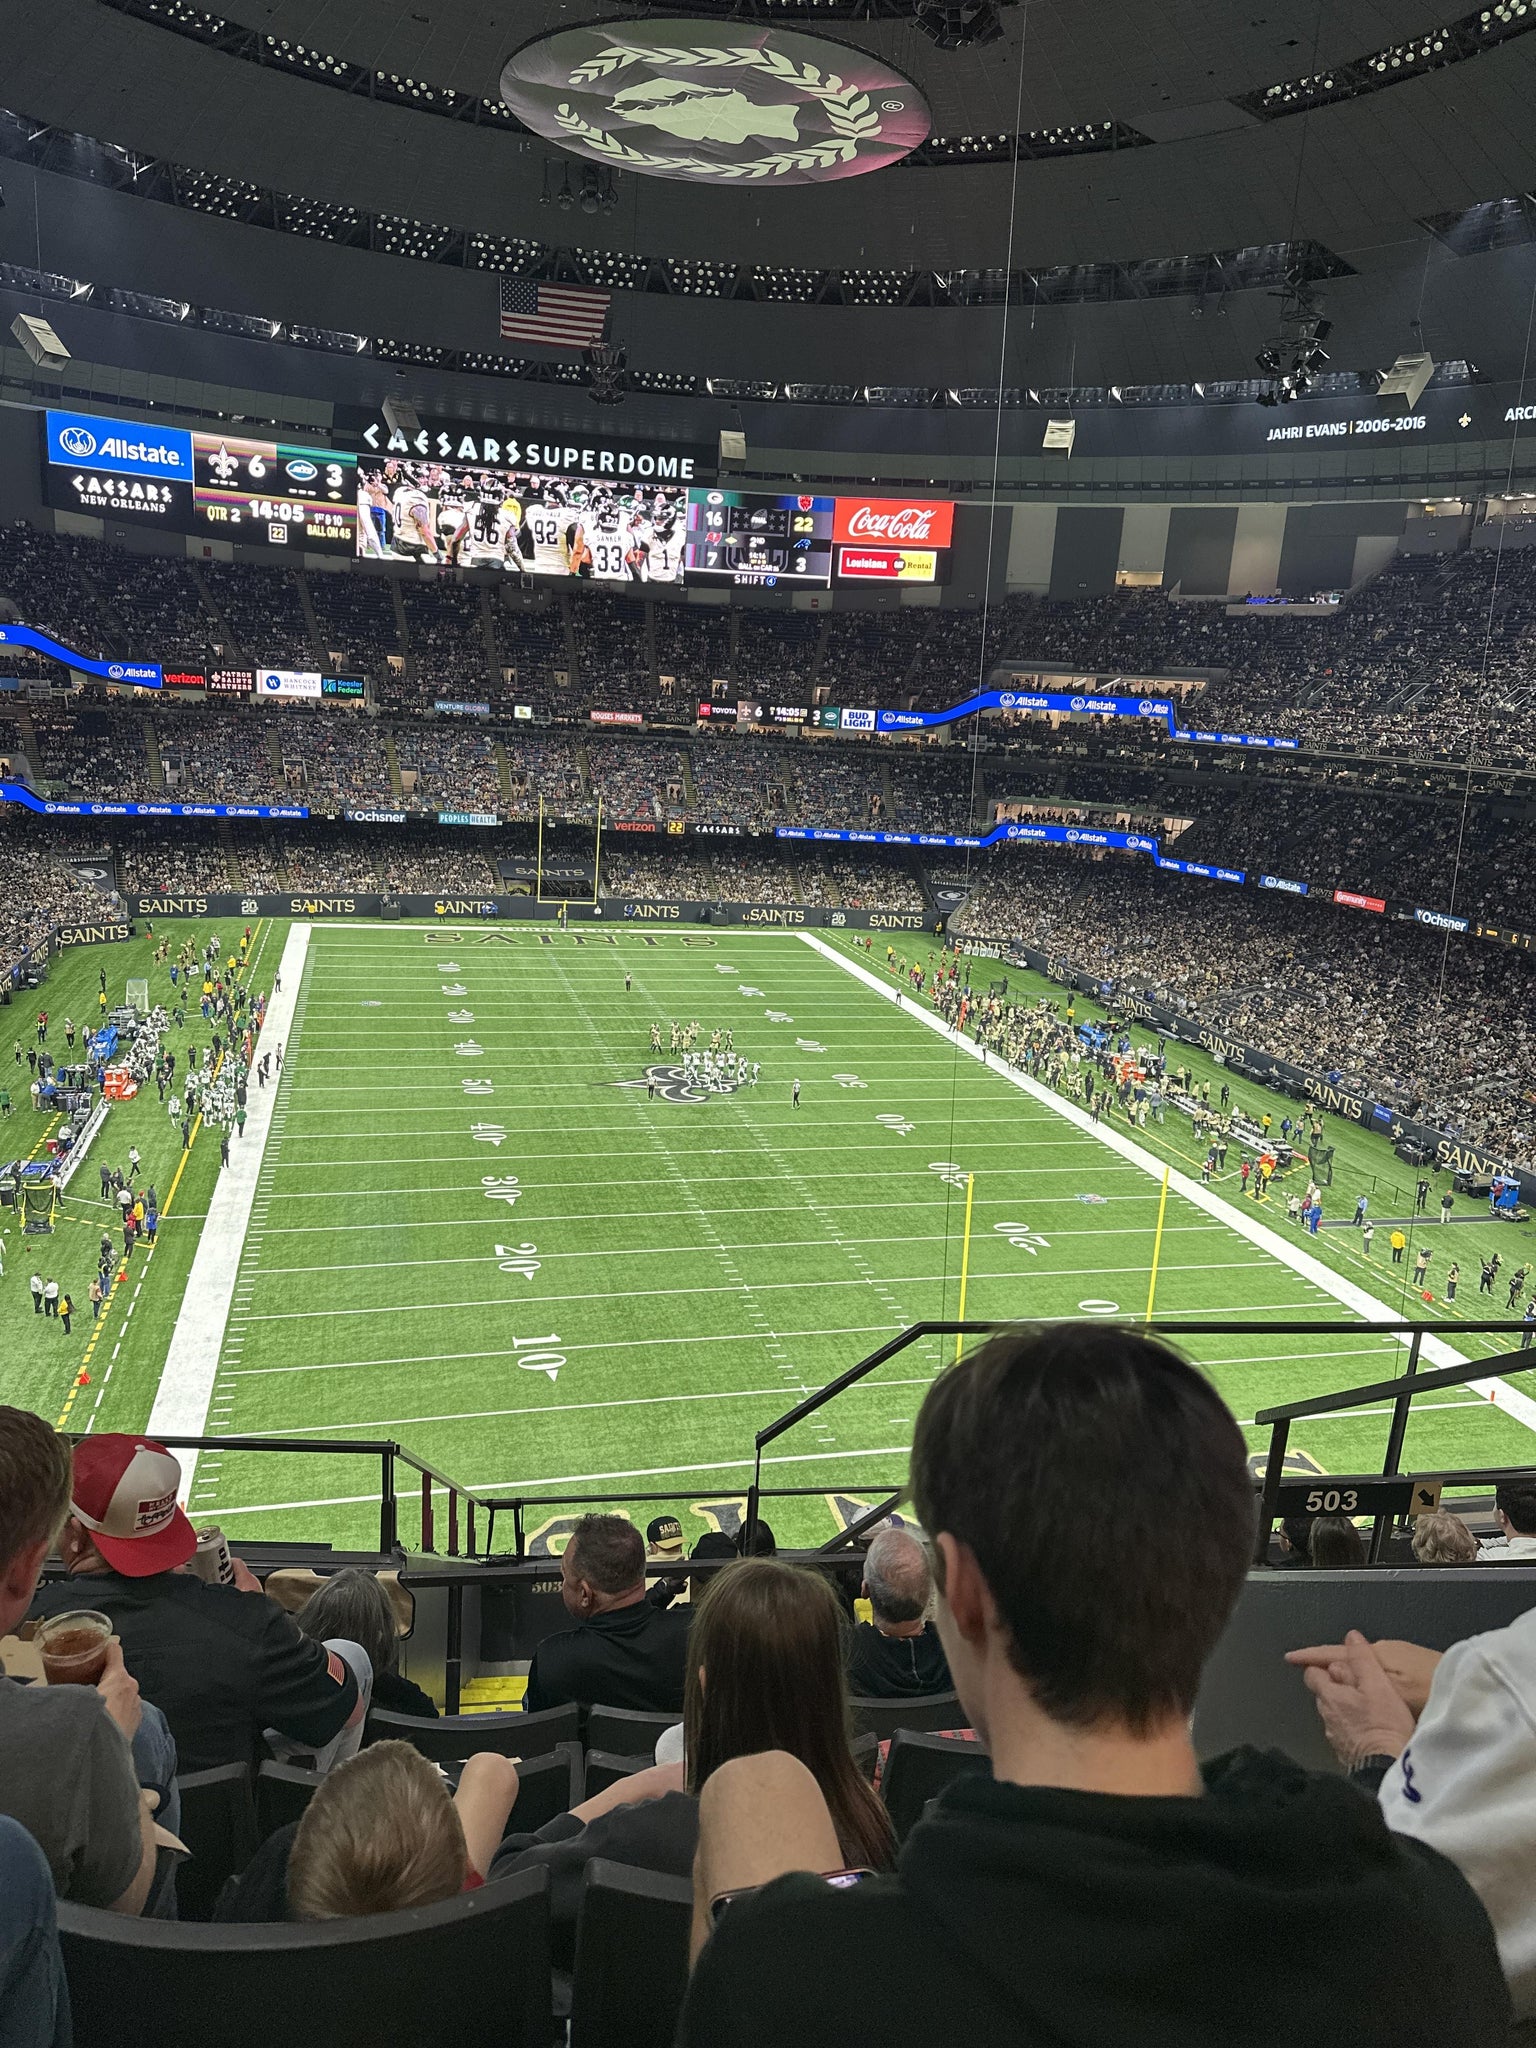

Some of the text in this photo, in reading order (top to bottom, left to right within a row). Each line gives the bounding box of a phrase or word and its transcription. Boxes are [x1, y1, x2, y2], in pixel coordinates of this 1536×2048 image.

[1267, 416, 1426, 441] JAHRI EVANS 2006-2016
[363, 423, 695, 480] CAESARS SUPERDOME
[248, 454, 266, 478] 6
[326, 463, 343, 487] 3
[72, 474, 173, 503] CAESARS
[80, 493, 166, 513] NEW ORLEANS
[207, 505, 241, 523] QTR 2
[249, 499, 305, 523] 14:05
[332, 514, 343, 527] 10
[705, 511, 723, 527] 16
[751, 516, 767, 524] FINAL
[794, 516, 814, 532] 22
[848, 505, 937, 540] Coca-Cola
[272, 526, 284, 539] 22
[306, 523, 352, 540] BALL ON 45
[473, 514, 500, 545] 56
[534, 519, 558, 545] 92
[596, 545, 623, 573] 33
[662, 548, 670, 570] 1
[707, 552, 718, 566] 7
[795, 557, 807, 573] 3
[846, 556, 888, 569] Louisiana
[907, 561, 932, 569] Rental
[163, 672, 204, 684] verizon
[221, 670, 252, 679] PATRON
[211, 683, 252, 691] PARTNERS
[337, 679, 363, 688] Keesler
[337, 686, 363, 694] Federal
[436, 702, 489, 712] VENTURE GLOBAL
[711, 706, 737, 714] TOYOTA
[754, 706, 763, 717] 6
[776, 706, 800, 717] 14:05
[614, 713, 642, 722] MARKETS
[812, 710, 821, 720] 3
[848, 711, 869, 720] BUD
[895, 715, 924, 725] Allstate
[844, 718, 872, 728] LIGHT
[1303, 741, 1328, 750] SAINTS
[1407, 751, 1435, 761] SAINTS
[310, 808, 340, 816] SAINTS
[354, 810, 405, 823] Ochsner
[440, 814, 496, 824] PEOPLES HEALTH
[507, 814, 534, 823] SAINTS
[566, 817, 592, 825] SAINTS
[613, 821, 656, 832] verizon
[669, 822, 683, 832] 22
[695, 825, 741, 835] CAESARS
[515, 866, 585, 878] SAINTS
[1309, 886, 1333, 898] SAINTS
[139, 898, 208, 914] SAINTS
[241, 901, 257, 913] 20
[290, 898, 356, 914] SAINTS
[750, 908, 805, 923] SAINTS
[869, 914, 923, 929] SAINTS
[1422, 911, 1467, 933] Ochsner
[60, 924, 129, 946] SAINTS
[1476, 927, 1482, 937] 3
[1511, 933, 1518, 944] 6
[424, 932, 719, 948] SAINTS
[955, 938, 1010, 952] SAINTS
[1199, 1031, 1245, 1063] SAINTS
[461, 1078, 495, 1095] 50
[831, 1073, 869, 1089] 50
[1303, 1078, 1363, 1119] SAINTS
[875, 1113, 916, 1133] 40
[470, 1122, 507, 1142] 40
[481, 1175, 523, 1199] 30
[993, 1221, 1052, 1250] 20
[495, 1242, 542, 1275] 20
[512, 1331, 568, 1373] 10
[1305, 1490, 1359, 1513] 503
[531, 1581, 563, 1594] 503
